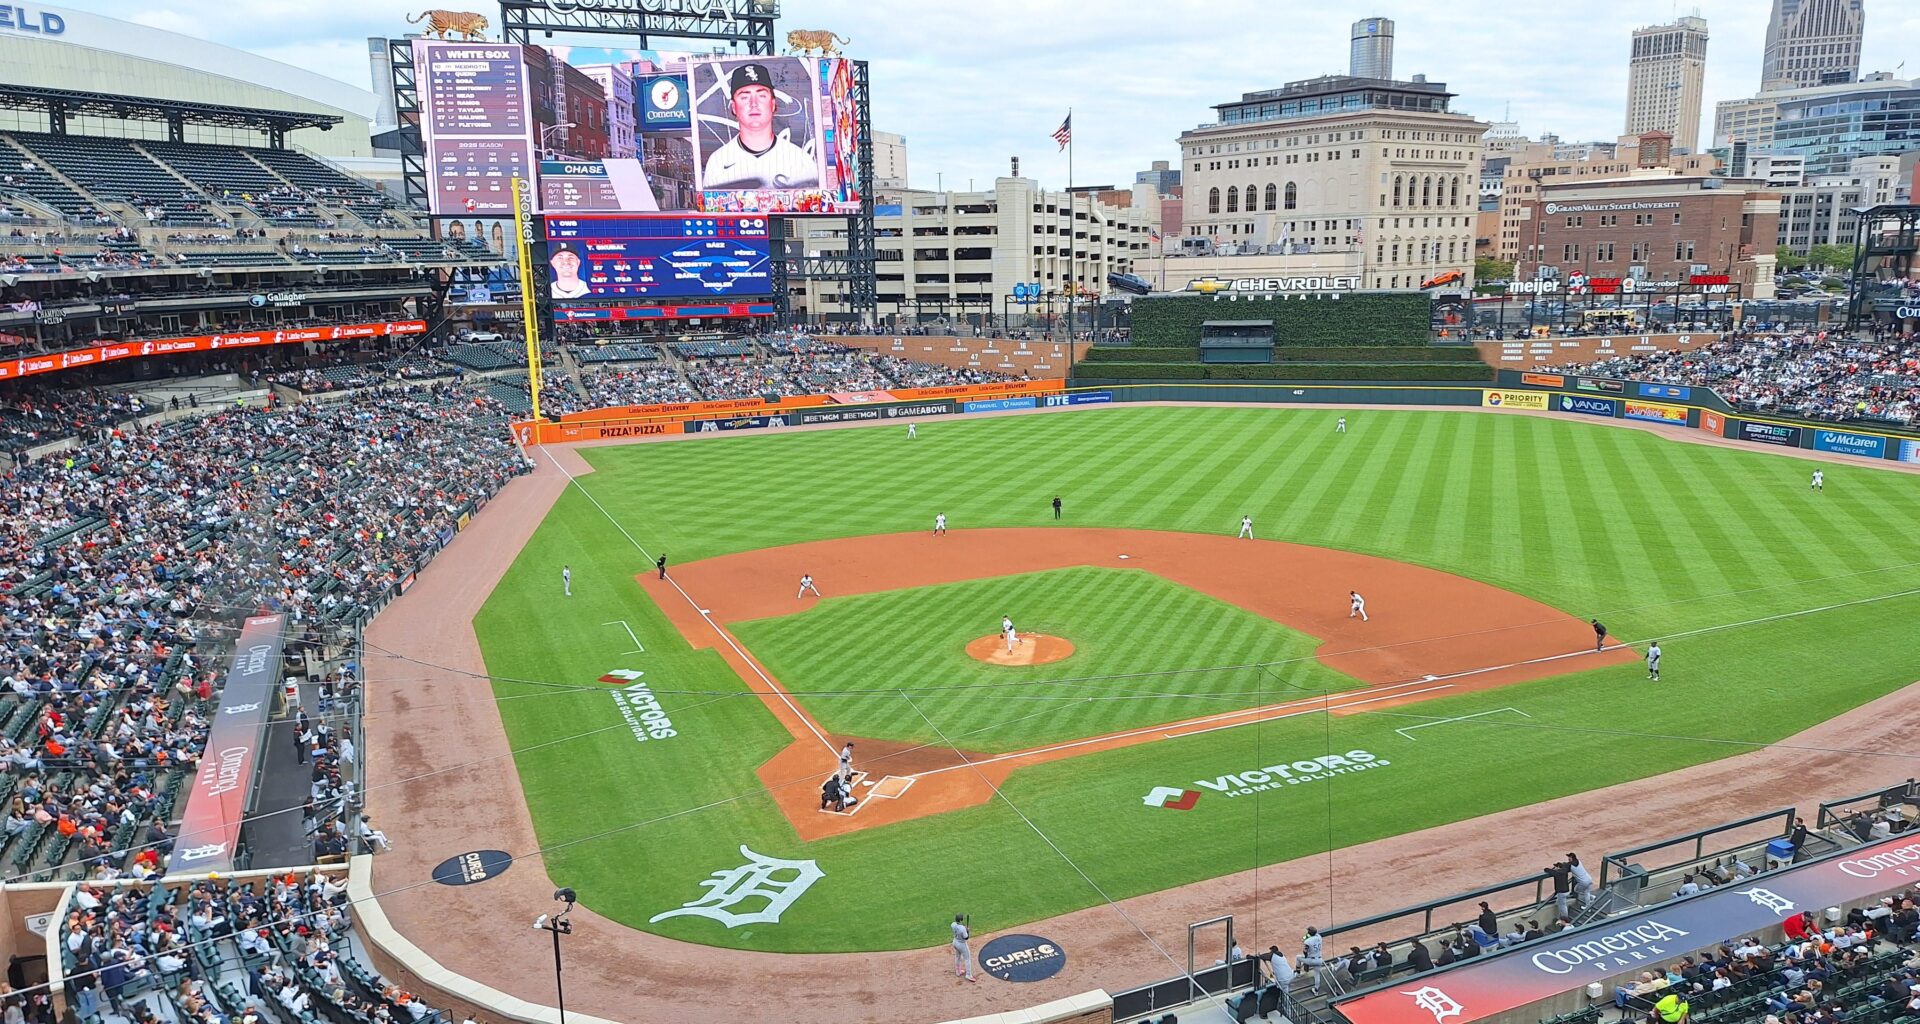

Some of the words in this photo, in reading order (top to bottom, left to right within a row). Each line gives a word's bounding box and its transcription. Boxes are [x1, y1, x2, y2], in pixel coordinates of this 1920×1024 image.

[601, 13, 687, 31] PARK
[564, 165, 604, 174] CHASE
[520, 194, 536, 245] Rocket
[1237, 276, 1361, 291] CHEVROLET
[1510, 278, 1560, 295] meijer
[1703, 285, 1728, 294] LAW
[267, 294, 306, 302] Gallagher
[1214, 293, 1340, 301] FOUNTAIN
[36, 308, 66, 320] CHAMPIONS
[494, 310, 523, 319] MARKET
[1047, 396, 1069, 406] DTE
[1574, 400, 1611, 411] VANDA
[898, 406, 947, 415] GAMEABOVE
[1630, 406, 1662, 418] Surfside
[600, 427, 632, 438] PIZZA!
[634, 425, 664, 435] PIZZA!
[1751, 433, 1788, 442] SPORTSBOOK
[1836, 434, 1877, 449] McLaren
[610, 689, 627, 706] HOME
[619, 705, 648, 742] SOLUTIONS
[624, 682, 678, 740] VICTORS
[1193, 750, 1376, 792] VICTORS
[1225, 782, 1282, 798] HOME
[1286, 760, 1391, 785] SOLUTIONS
[986, 947, 1038, 967] CURE
[992, 963, 1012, 972] AUTO
[1015, 952, 1059, 967] INSURANCE
[1594, 945, 1665, 971] PARK
